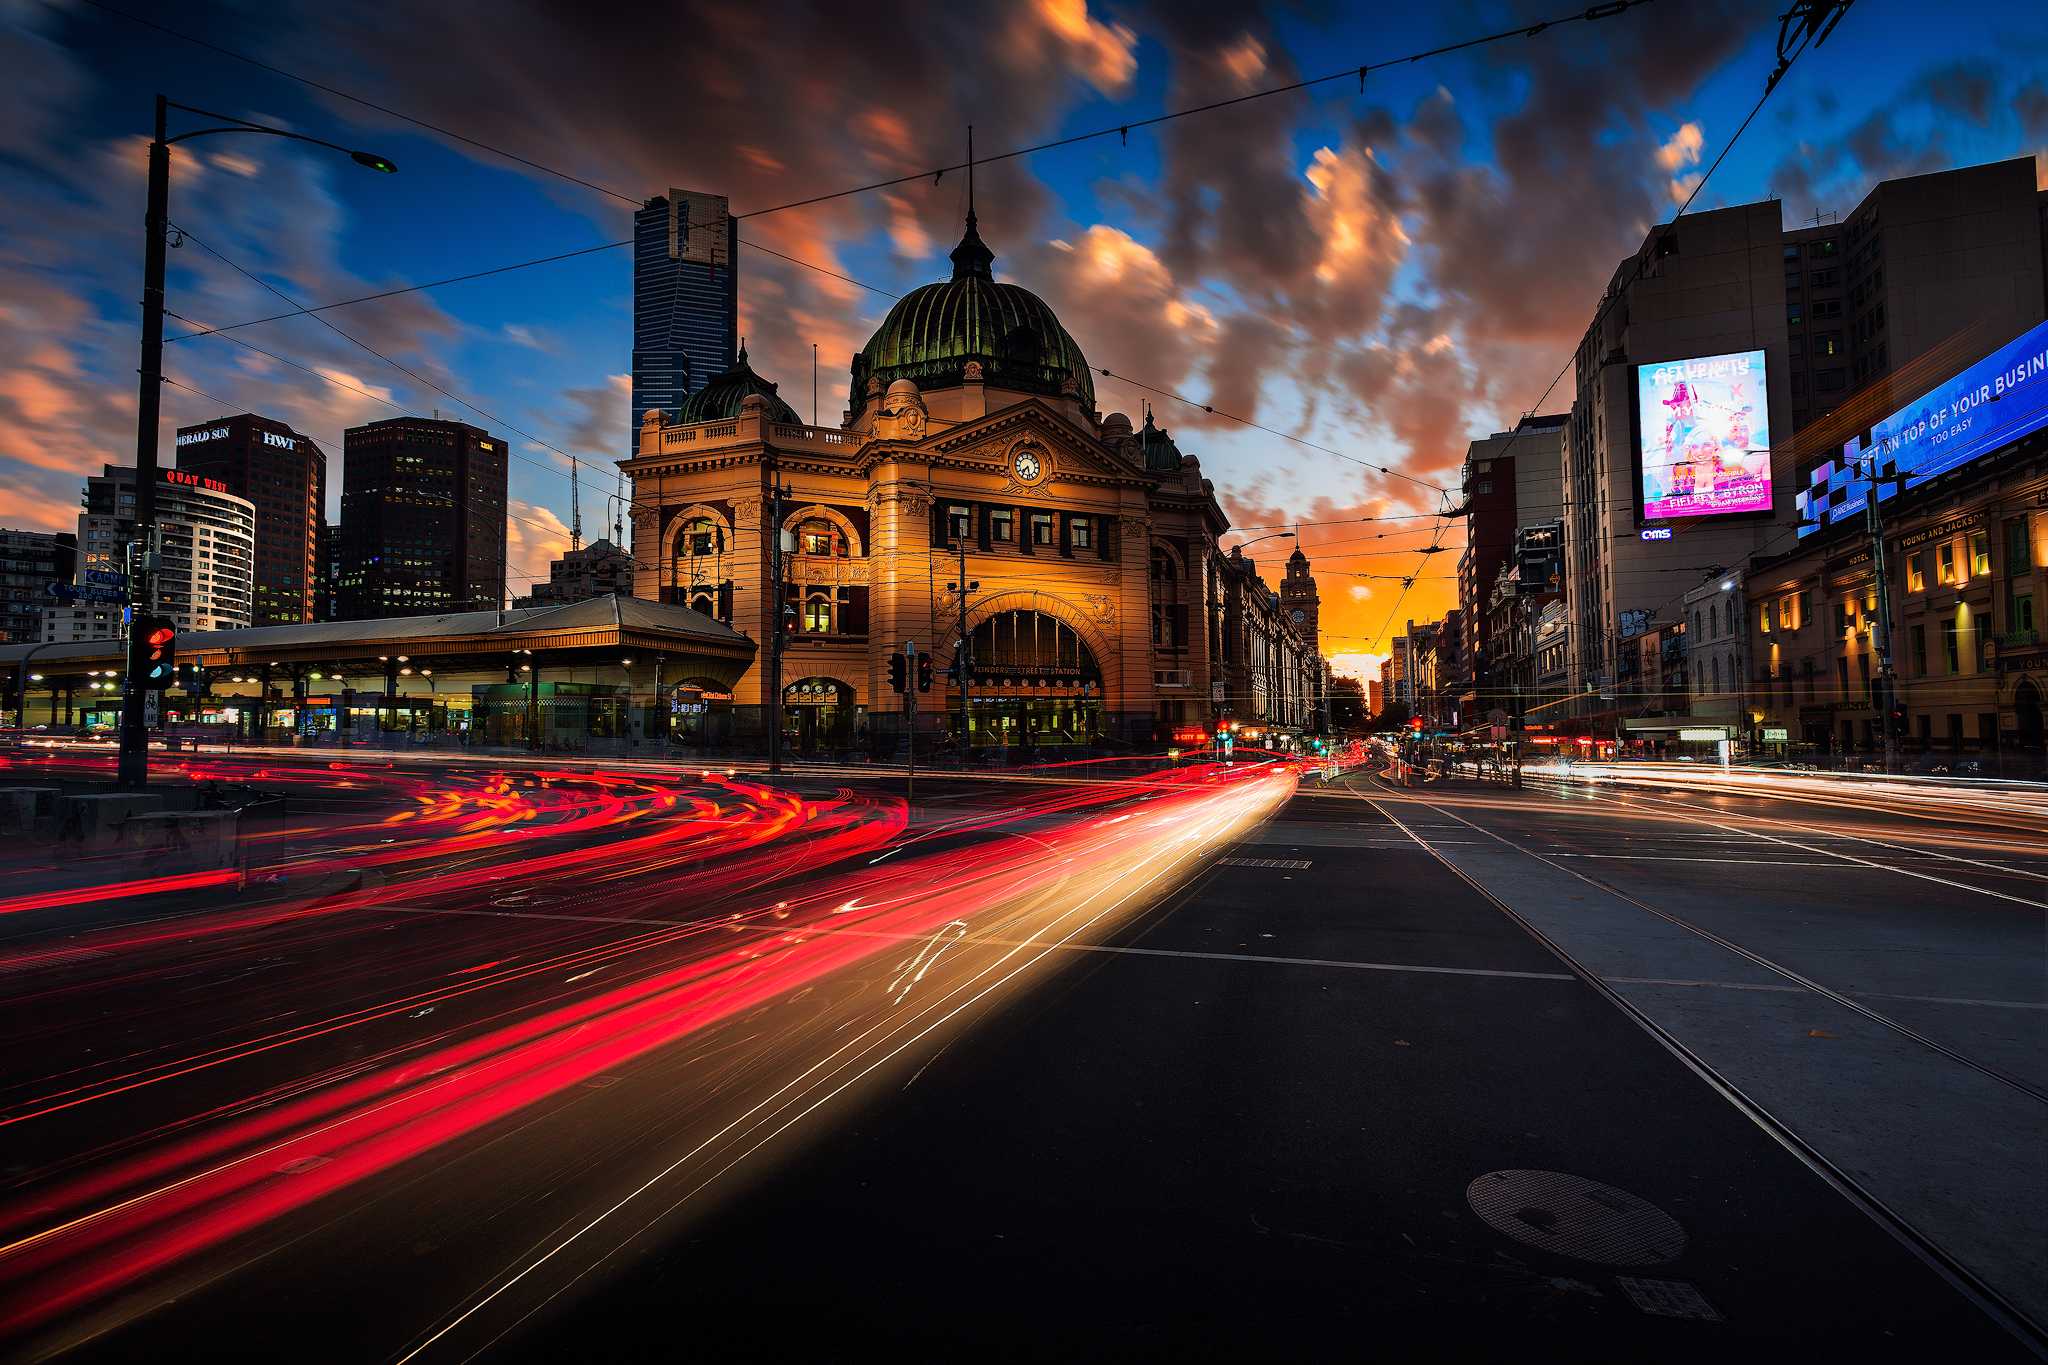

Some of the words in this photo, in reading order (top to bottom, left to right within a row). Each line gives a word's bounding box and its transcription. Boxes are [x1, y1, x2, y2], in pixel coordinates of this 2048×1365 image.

[1860, 446, 1880, 467] GET
[1901, 421, 1926, 447] TOP
[1929, 408, 1948, 431] OF
[1950, 384, 1991, 417] YOUR
[1995, 349, 2048, 395] BUSIN
[175, 432, 210, 446] HERALD
[211, 427, 230, 440] SUN
[263, 432, 297, 450] HWT
[1930, 432, 1949, 447] TOO
[1951, 417, 1974, 436] EASY
[166, 470, 199, 486] QUAY
[204, 477, 228, 493] WEST
[1902, 533, 1926, 548] YOUNG
[1928, 525, 1945, 541] AND
[1849, 553, 1869, 566] HOTEL
[1050, 667, 1081, 675] STATION
